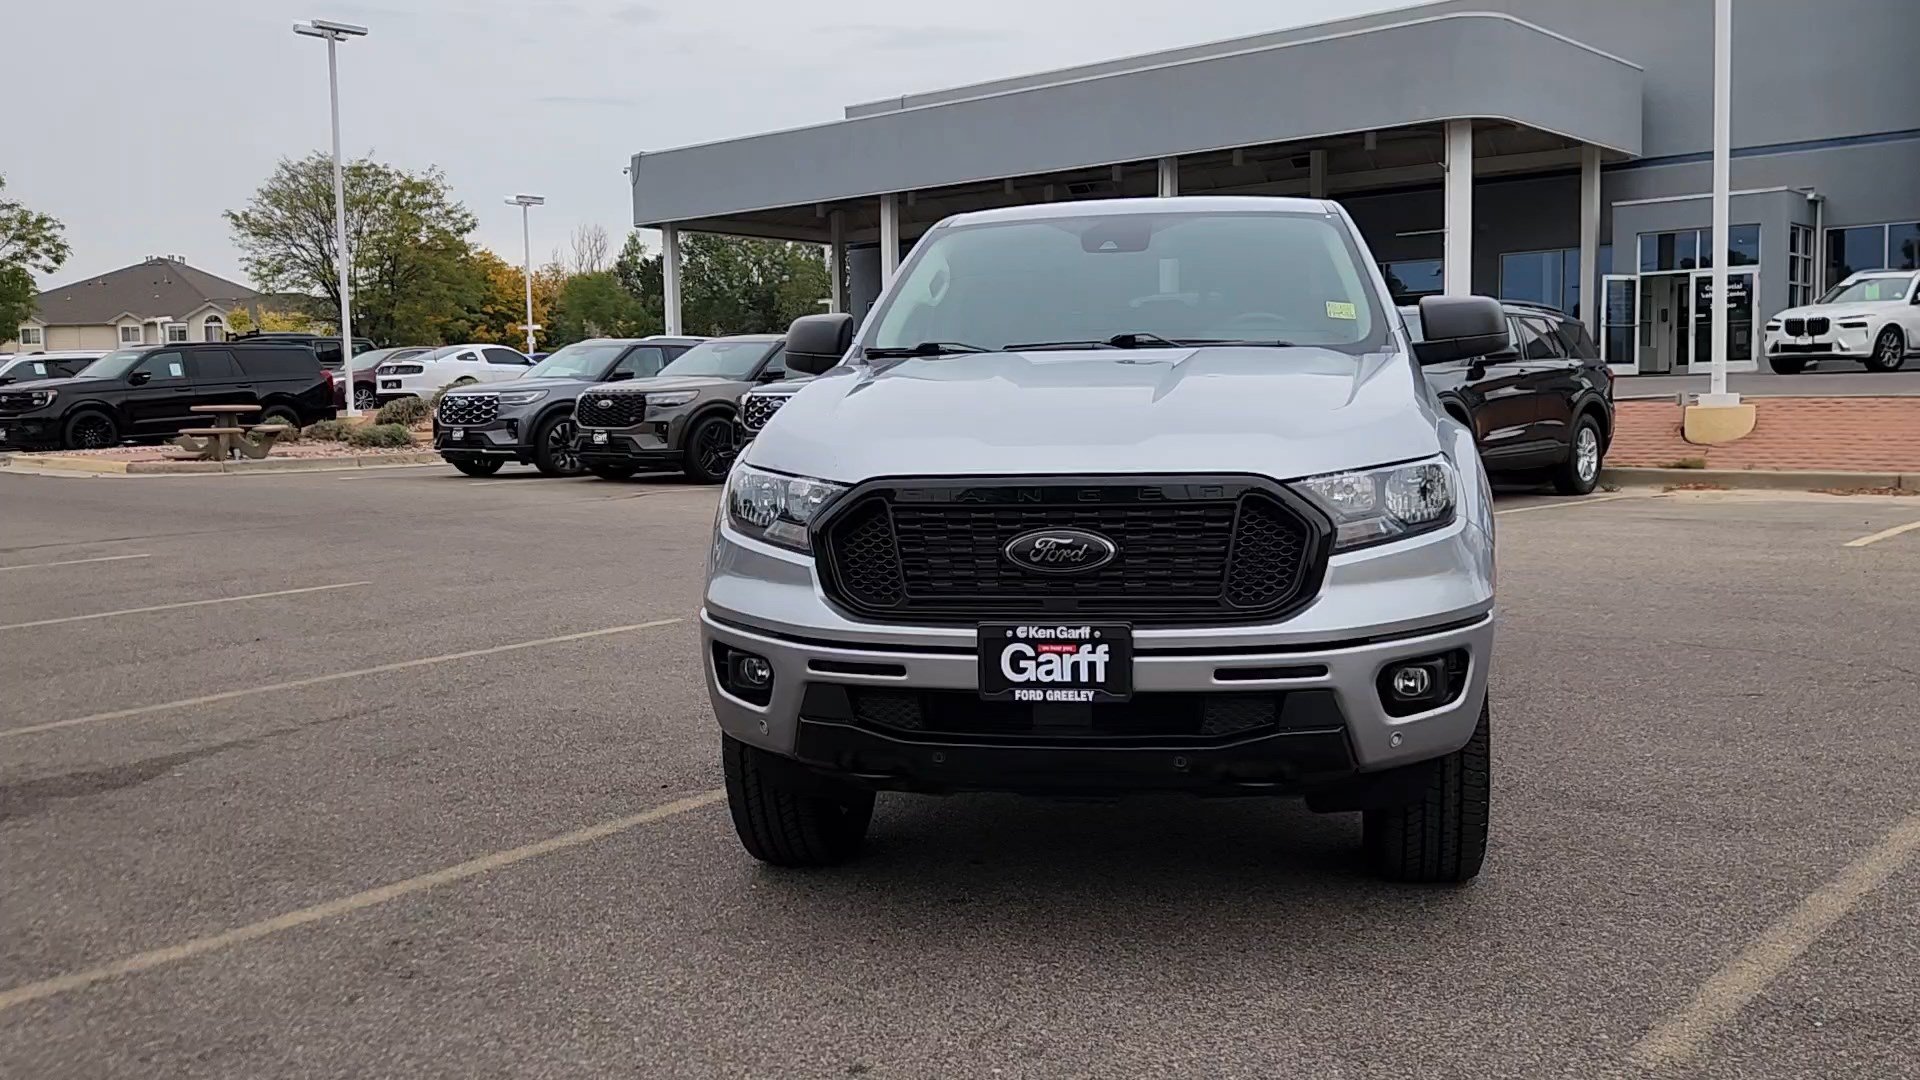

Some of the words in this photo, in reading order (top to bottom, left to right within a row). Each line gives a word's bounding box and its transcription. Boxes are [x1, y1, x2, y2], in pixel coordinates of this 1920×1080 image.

[1029, 537, 1088, 562] Ford
[1028, 626, 1055, 639] Ken
[1056, 626, 1091, 639] Garff
[1000, 642, 1109, 683] Garff
[1014, 689, 1044, 701] FORD
[1046, 689, 1095, 702] GREELEY
